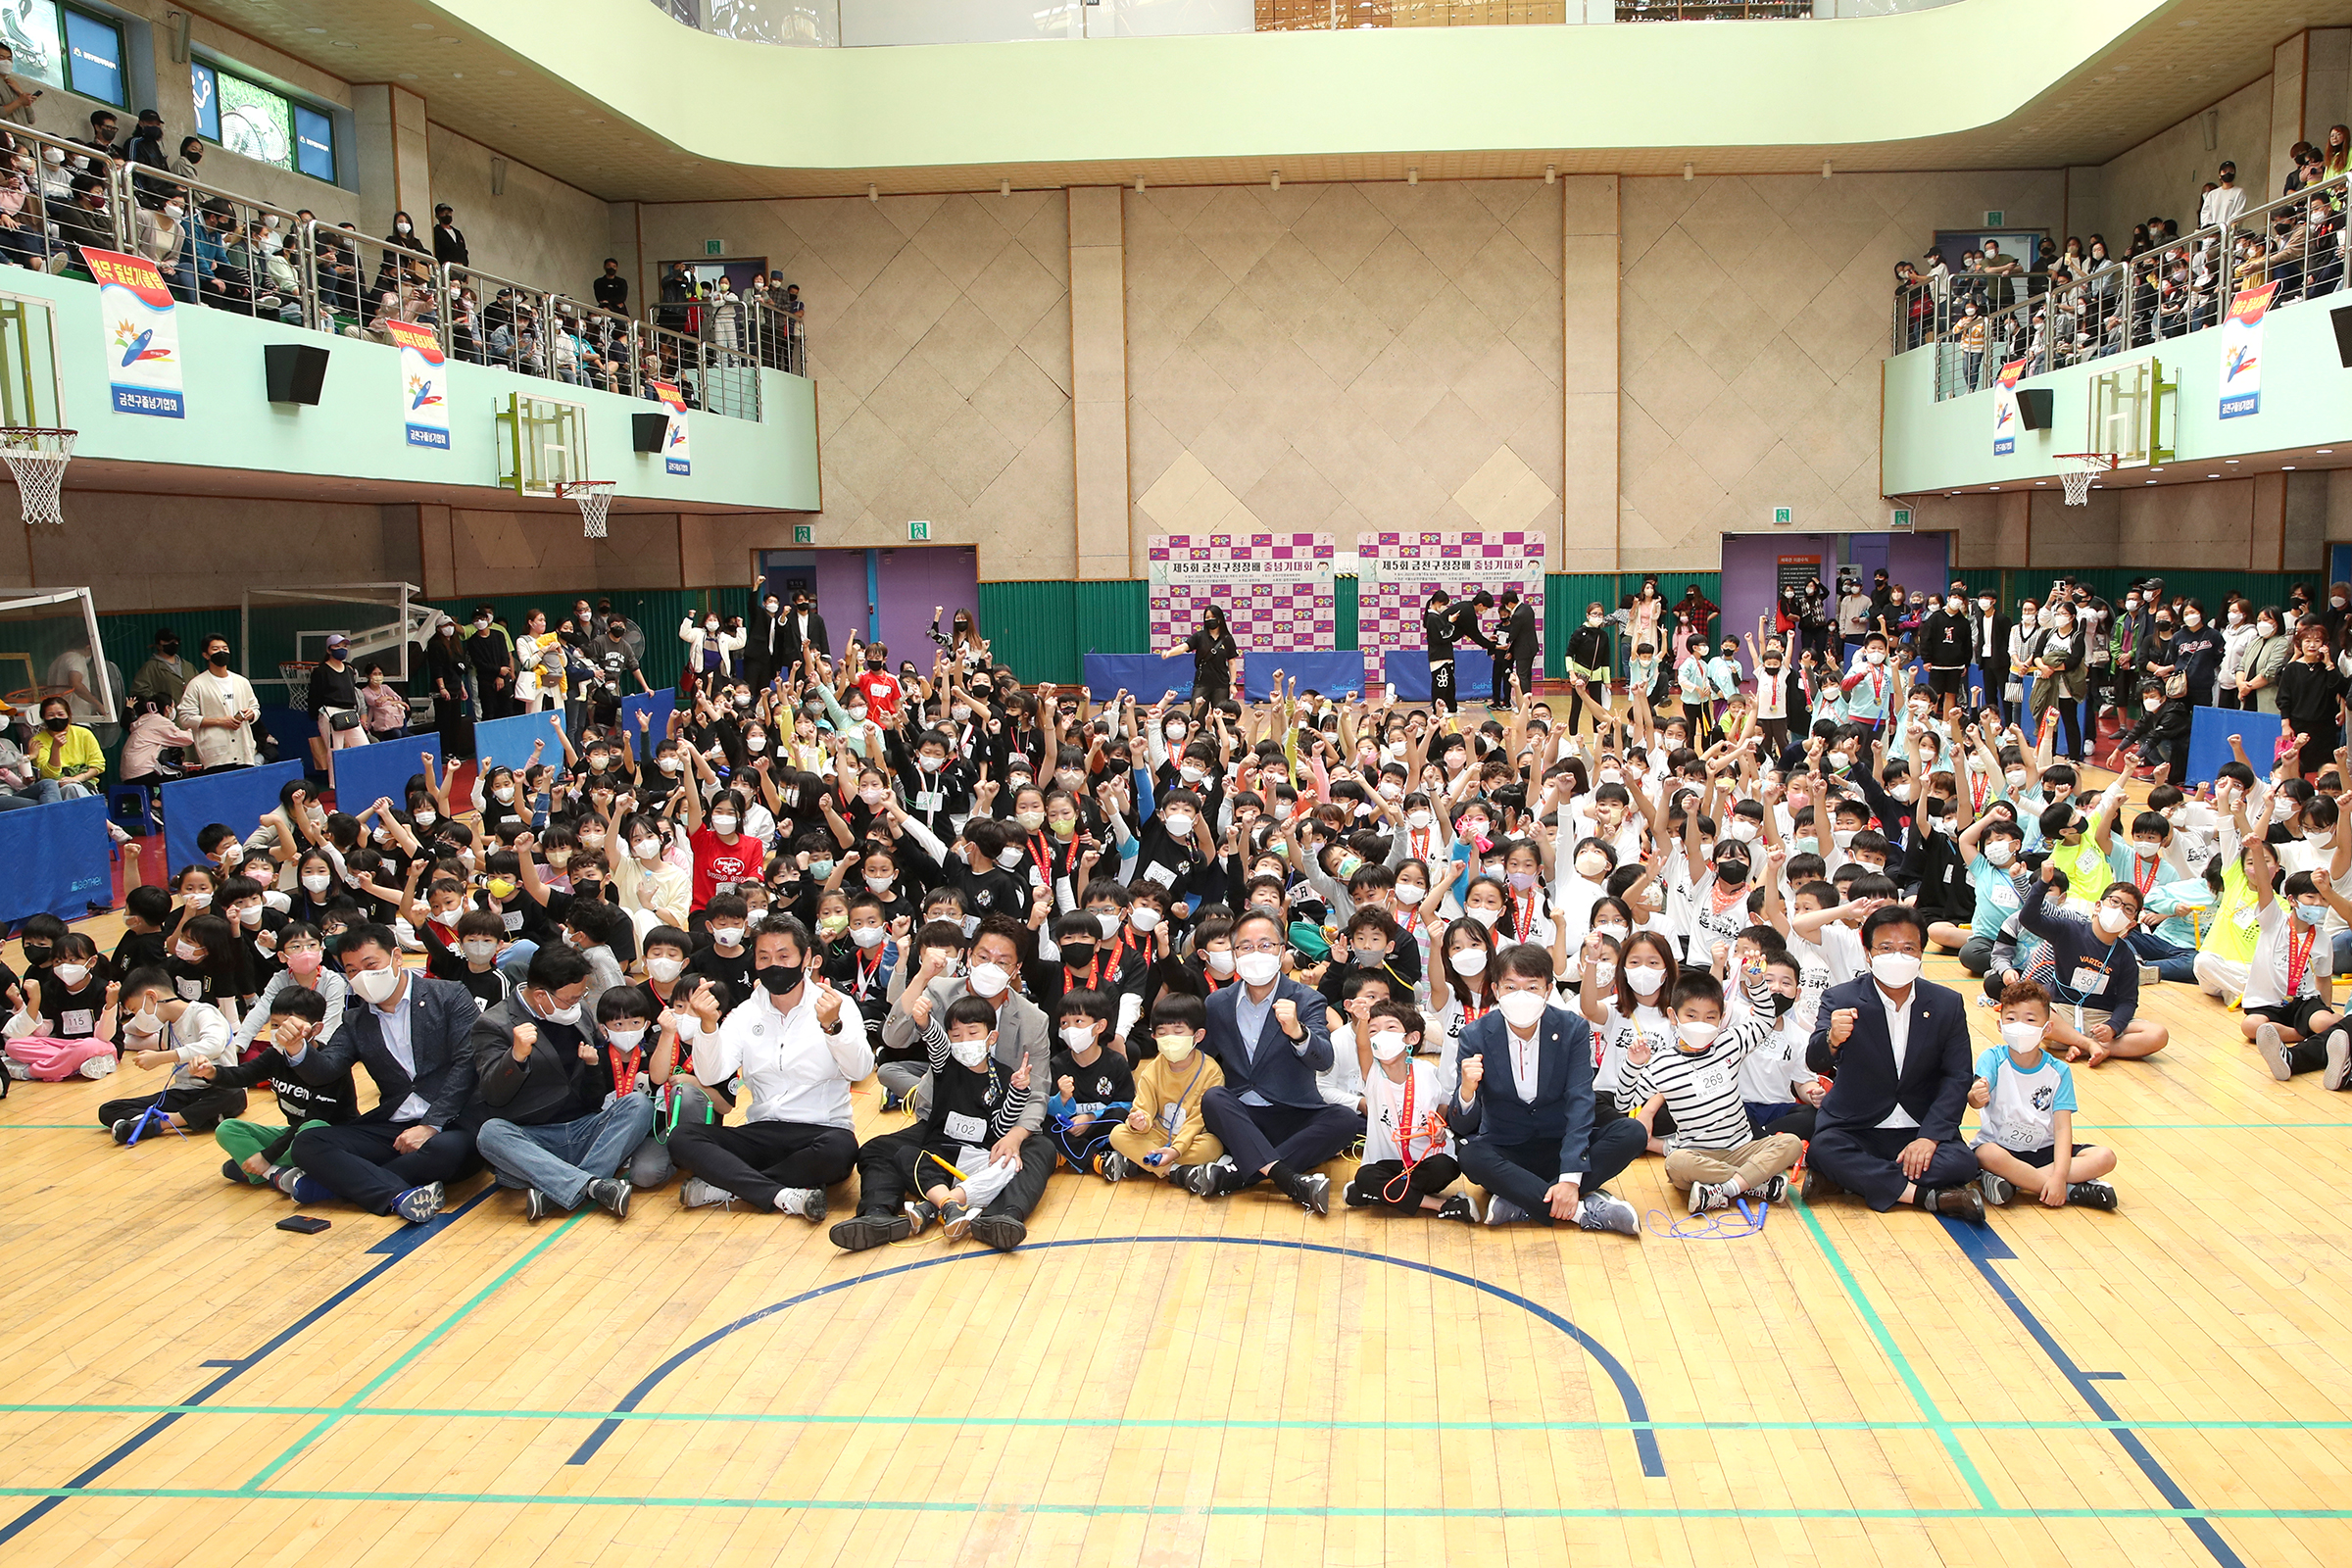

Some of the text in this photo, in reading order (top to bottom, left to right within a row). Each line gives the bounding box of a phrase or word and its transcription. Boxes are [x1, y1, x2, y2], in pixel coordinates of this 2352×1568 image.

[113, 263, 166, 291] 줄넘기클럽
[119, 393, 178, 412] 금천구줄넘기협회
[1172, 561, 1313, 573] 제5회 금천구청장배 줄넘기대회
[1382, 559, 1524, 570] 제5회 금천구청장배 줄넘기대회
[1152, 869, 1168, 883] 302
[504, 915, 519, 926] 213
[68, 1017, 85, 1026] 115
[1702, 1072, 1725, 1089] 269
[1080, 1102, 1099, 1113] 101
[955, 1121, 982, 1136] 102
[2010, 1129, 2034, 1145] 270
